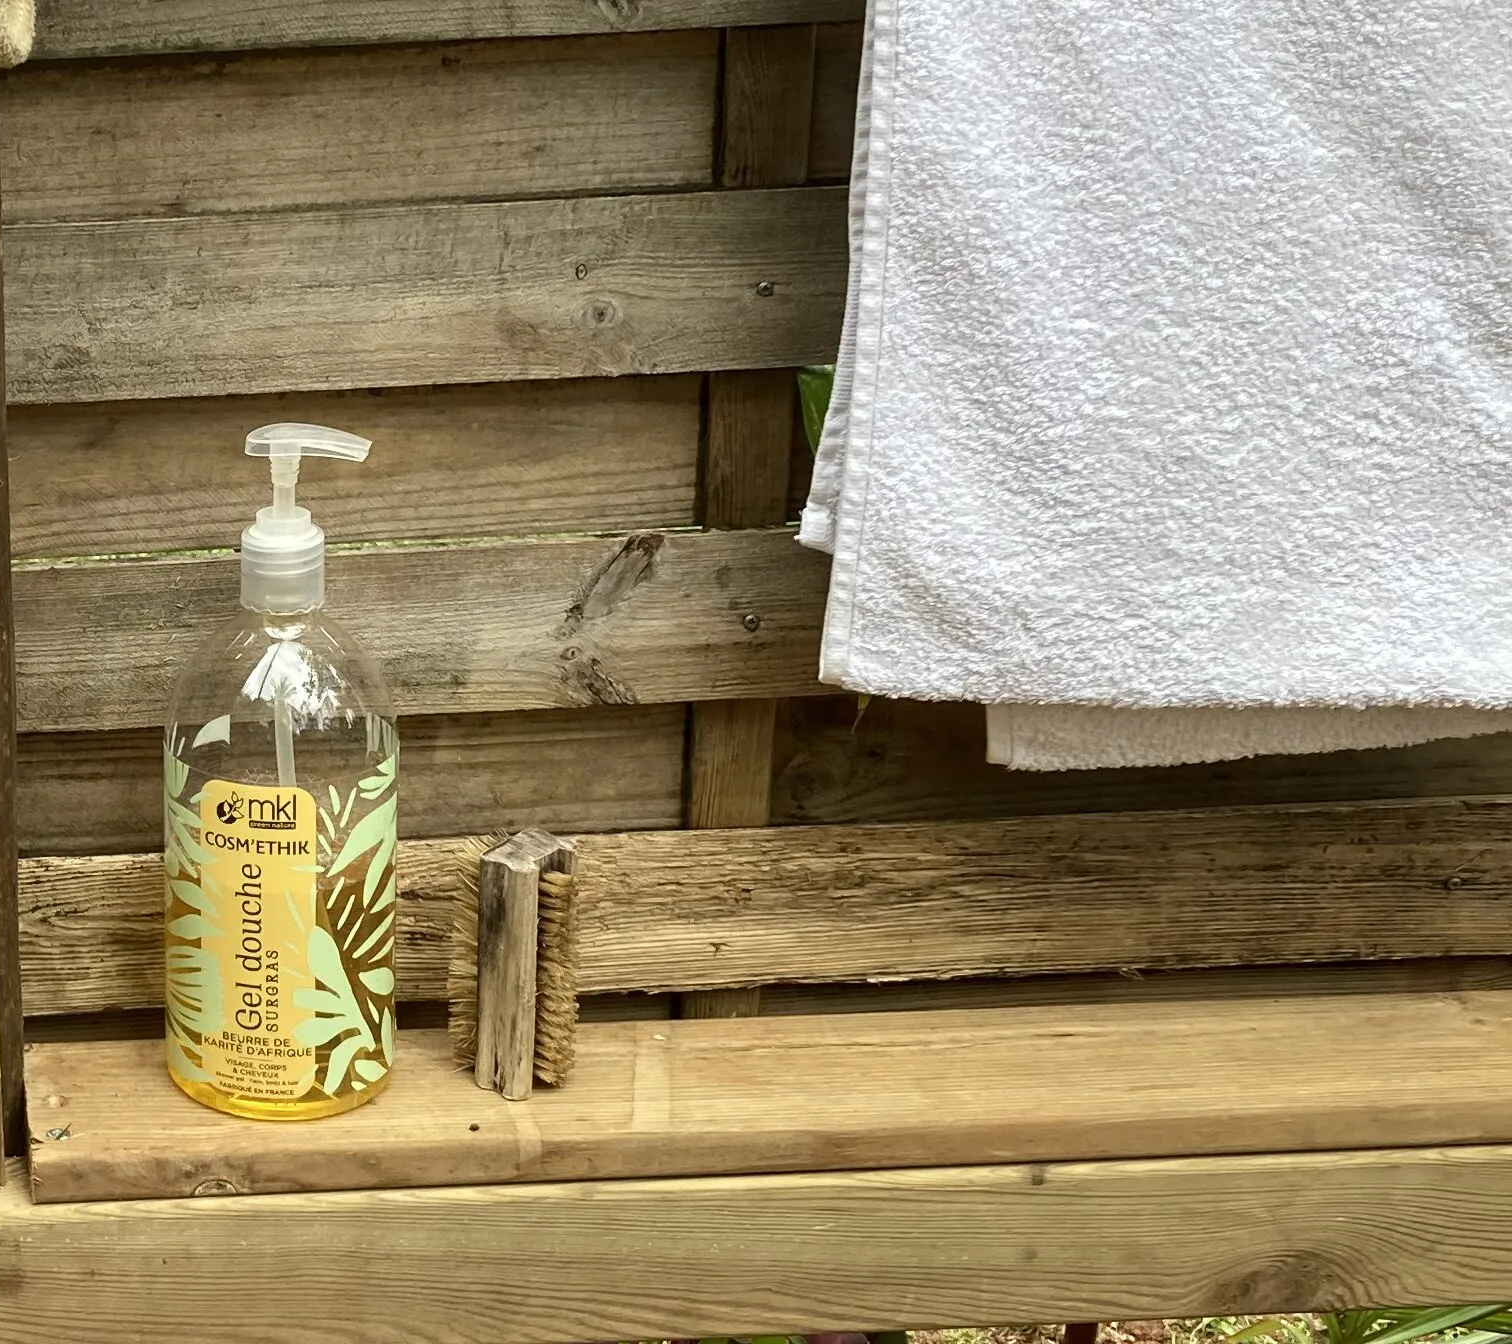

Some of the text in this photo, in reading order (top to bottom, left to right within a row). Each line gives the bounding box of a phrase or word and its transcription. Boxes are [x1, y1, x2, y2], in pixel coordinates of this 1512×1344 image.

[249, 794, 296, 821] mkl
[205, 832, 310, 855] COSM'ETHIK
[235, 863, 263, 1031] Gel douche
[266, 950, 279, 1033] SURGRAS
[203, 1036, 313, 1058] KARITÉ D'AFRIQUE
[222, 1031, 291, 1047] BEURRE DE
[239, 1069, 279, 1079] CHEVEUX
[258, 1063, 288, 1072] CORPS
[219, 1080, 252, 1094] FABRIQUÉ
[265, 1088, 295, 1096] FRANCE
